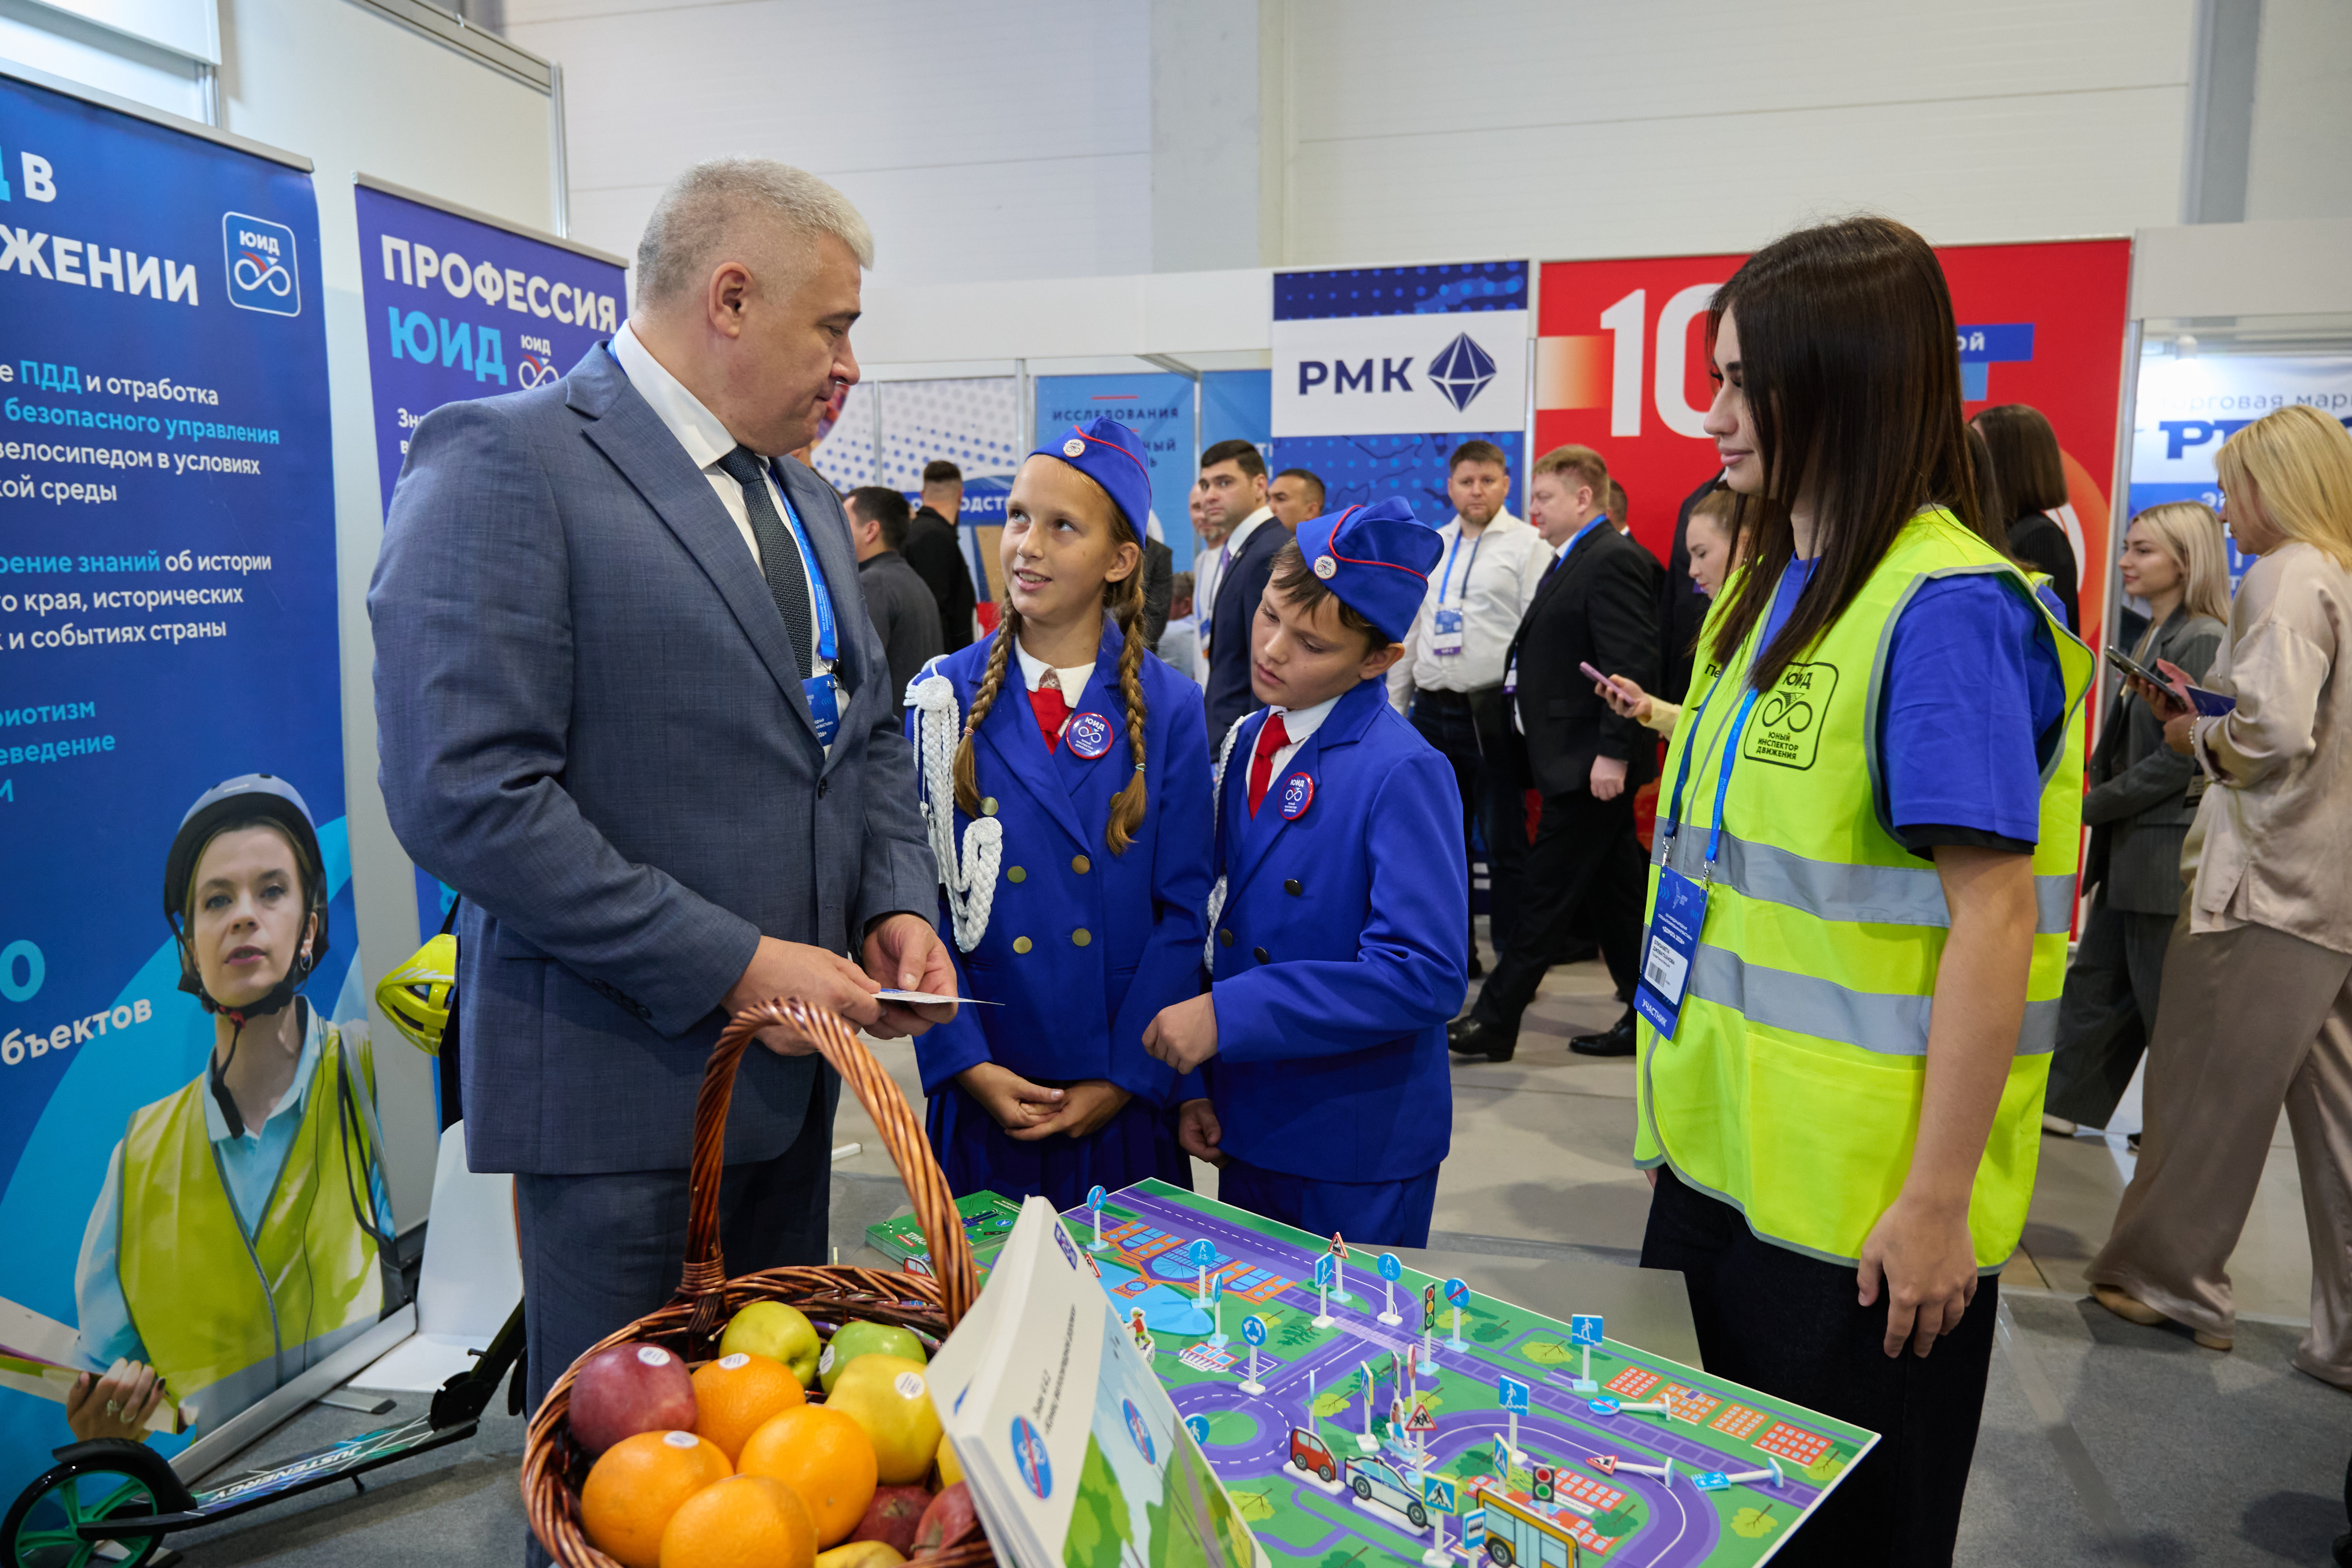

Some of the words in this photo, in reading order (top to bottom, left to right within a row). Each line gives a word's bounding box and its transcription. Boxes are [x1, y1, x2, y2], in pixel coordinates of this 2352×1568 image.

[239, 230, 280, 256] ЮИД
[381, 234, 617, 334] ПРОФЕССИЯ
[388, 306, 507, 386] ЮИД
[521, 334, 551, 356] ЮИД
[20, 360, 82, 394] ПДД
[86, 375, 101, 393] и
[107, 378, 219, 406] отработка
[1298, 357, 1414, 396] РМК
[1053, 408, 1179, 421] ИССЛЕДОВАНИЯ
[2296, 393, 2352, 411] мар
[5, 397, 160, 433] безопасного
[165, 418, 280, 444] управления
[158, 452, 170, 469] в
[174, 453, 261, 475] условиях
[0, 474, 35, 498] ой
[41, 479, 117, 505] среды
[78, 550, 160, 573] знаний
[165, 549, 193, 572] об
[198, 554, 271, 576] истории
[24, 592, 88, 617] края,
[93, 588, 244, 612] исторических
[9, 632, 24, 650] и
[31, 623, 146, 648] событиях
[150, 621, 227, 645] страны
[1782, 672, 1813, 690] ЮИД
[1085, 717, 1105, 732] ЮИД
[1768, 731, 1790, 742] ЮНЫЙ
[1756, 746, 1796, 760] ДВИЖЕНИЯ
[1757, 738, 1799, 752] ИНСПЕКТОР
[1290, 779, 1305, 788] ЮИД
[1642, 998, 1667, 1027] УЧАСТНИК
[1, 999, 152, 1066] бъектов
